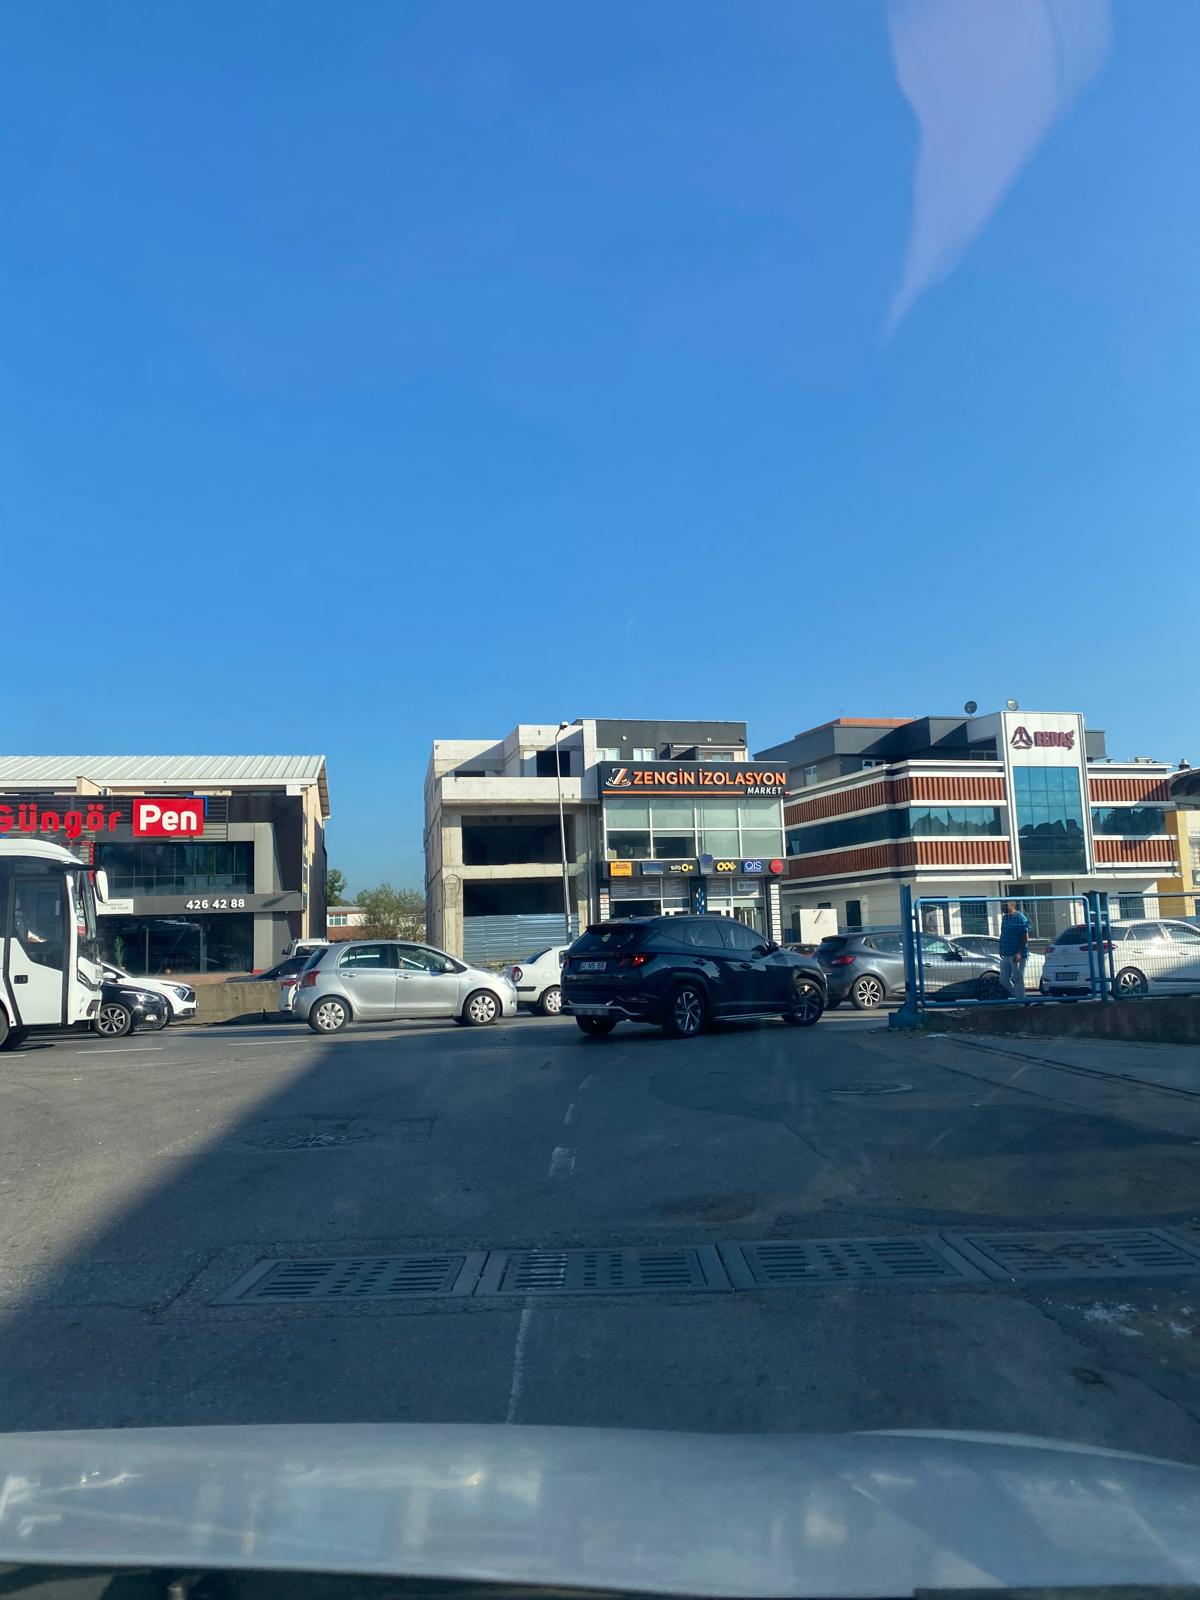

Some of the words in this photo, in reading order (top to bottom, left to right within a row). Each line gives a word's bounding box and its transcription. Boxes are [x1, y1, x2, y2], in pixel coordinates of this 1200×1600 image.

[633, 768, 695, 785] ZENGİN
[698, 768, 786, 785] İZOLASYON
[747, 786, 782, 795] MARKET
[139, 804, 197, 831] Pen
[186, 899, 209, 909] 426
[212, 899, 227, 909] 42
[230, 898, 245, 908] 88
